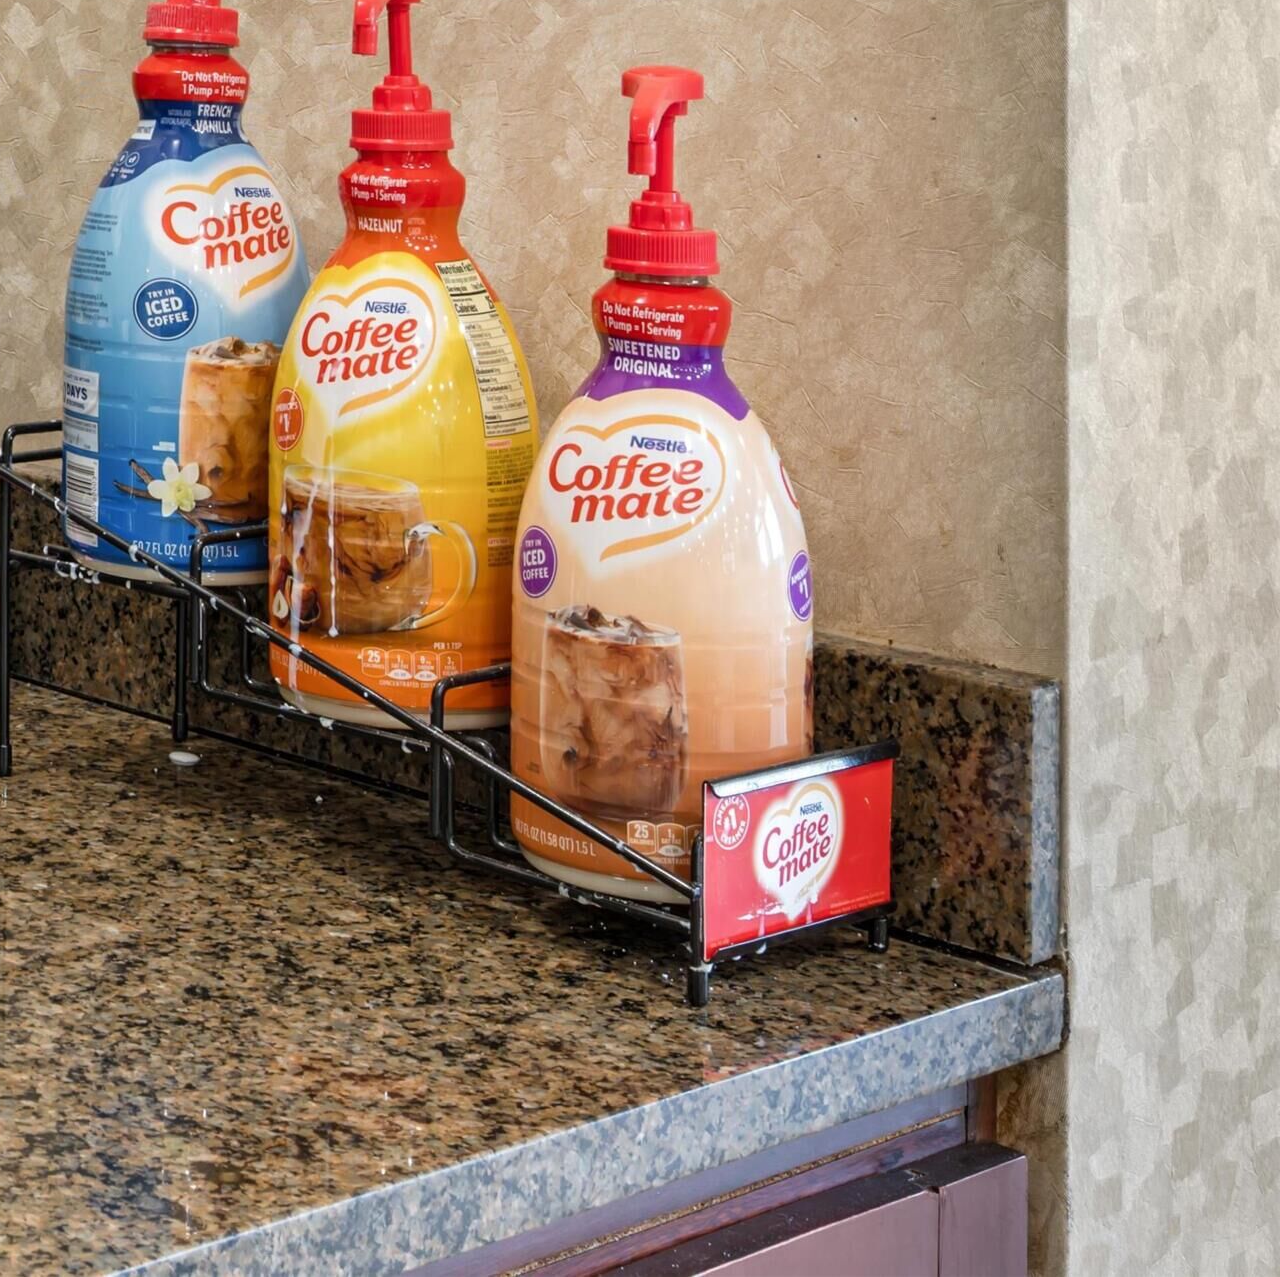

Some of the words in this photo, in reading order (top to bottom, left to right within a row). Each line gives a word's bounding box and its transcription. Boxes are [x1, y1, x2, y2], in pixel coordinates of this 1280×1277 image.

[181, 70, 194, 82] Do
[195, 71, 211, 83] Not
[188, 83, 213, 98] Pump
[197, 103, 233, 118] FRENCH
[195, 119, 233, 134] VANILLA
[235, 186, 273, 199] Nestlé
[380, 189, 406, 204] Serving
[161, 200, 283, 247] Coffee
[357, 216, 403, 234] HAZELNUT
[203, 224, 290, 270] mate
[148, 290, 163, 299] TRY
[164, 288, 175, 297] IN
[145, 298, 183, 316] ICED
[364, 300, 408, 314] Nestlé
[603, 300, 613, 314] Do
[614, 303, 630, 316] Not
[632, 305, 684, 323] Refrigerate
[147, 312, 190, 328] COFFEE
[604, 316, 608, 327] 1
[608, 316, 633, 333] Pump
[641, 322, 645, 334] 1
[646, 322, 682, 340] Serving
[301, 311, 418, 358] Coffee
[608, 337, 681, 360] SWEETENED
[316, 345, 419, 384] mate
[614, 356, 674, 378] ORIGINAL
[66, 383, 88, 401] DAYS
[630, 435, 688, 454] Nestlé
[548, 443, 703, 493] Coffee
[570, 488, 705, 523] mate
[152, 542, 162, 555] FL
[164, 543, 177, 556] OZ
[234, 546, 239, 557] L
[525, 538, 534, 548] TRY
[535, 538, 542, 547] IN
[523, 550, 545, 567] ICED
[523, 567, 549, 581] COFFEE
[368, 649, 380, 662] 25
[634, 824, 649, 838] 25
[540, 827, 558, 846] (1.58
[559, 833, 574, 851] QT)
[576, 839, 588, 855] 1.5
[590, 843, 596, 857] L
[763, 813, 829, 869] Coffee
[778, 835, 831, 887] mate
